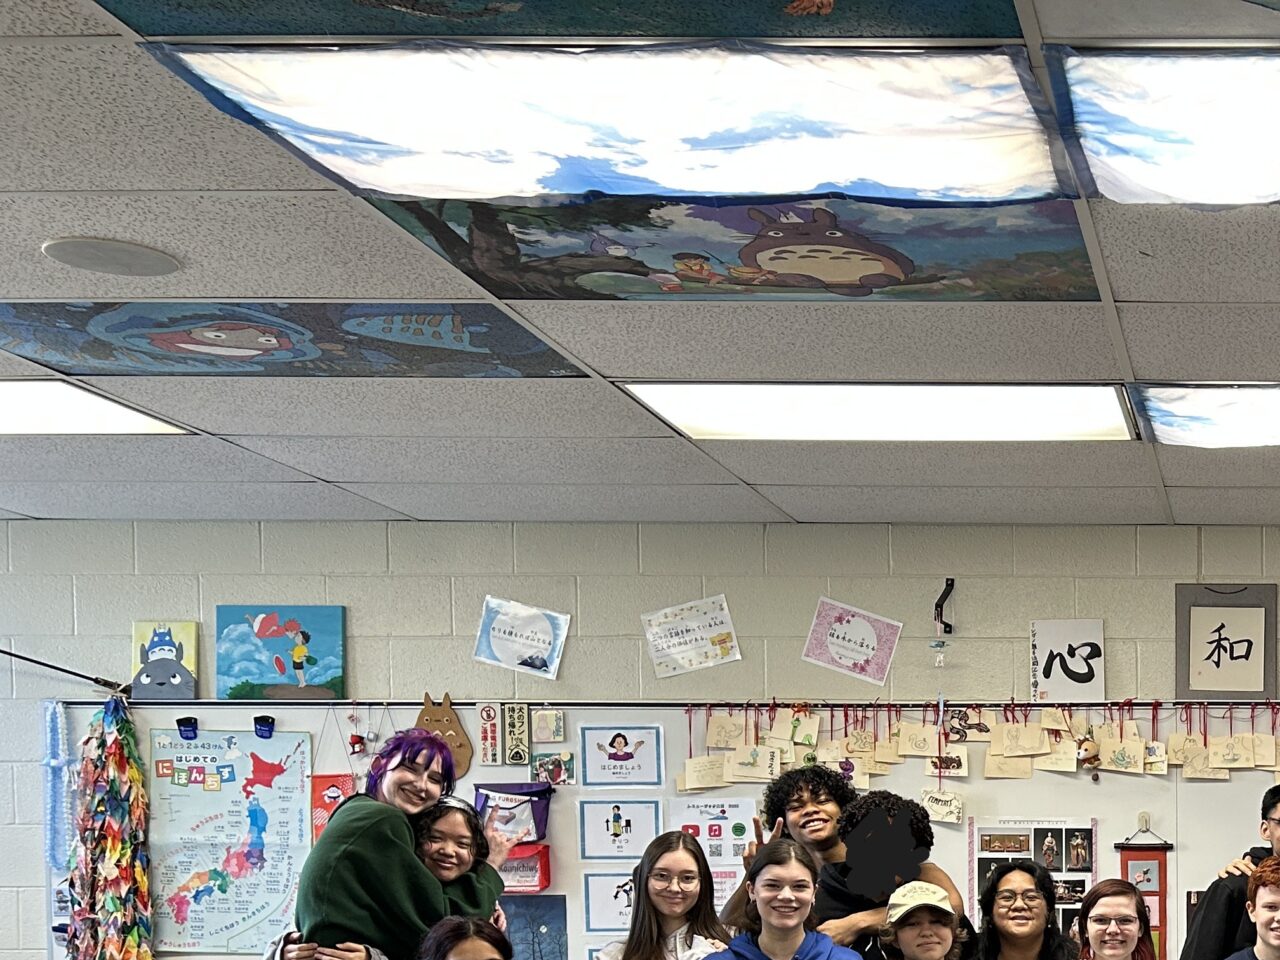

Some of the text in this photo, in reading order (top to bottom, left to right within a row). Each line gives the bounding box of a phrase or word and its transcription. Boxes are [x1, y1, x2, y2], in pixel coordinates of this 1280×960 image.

[1203, 622, 1254, 669] 和
[1042, 641, 1102, 684] 心
[517, 706, 525, 736] 犬のフン
[157, 762, 233, 789] にほんちず
[209, 920, 239, 936] しこくちほう
